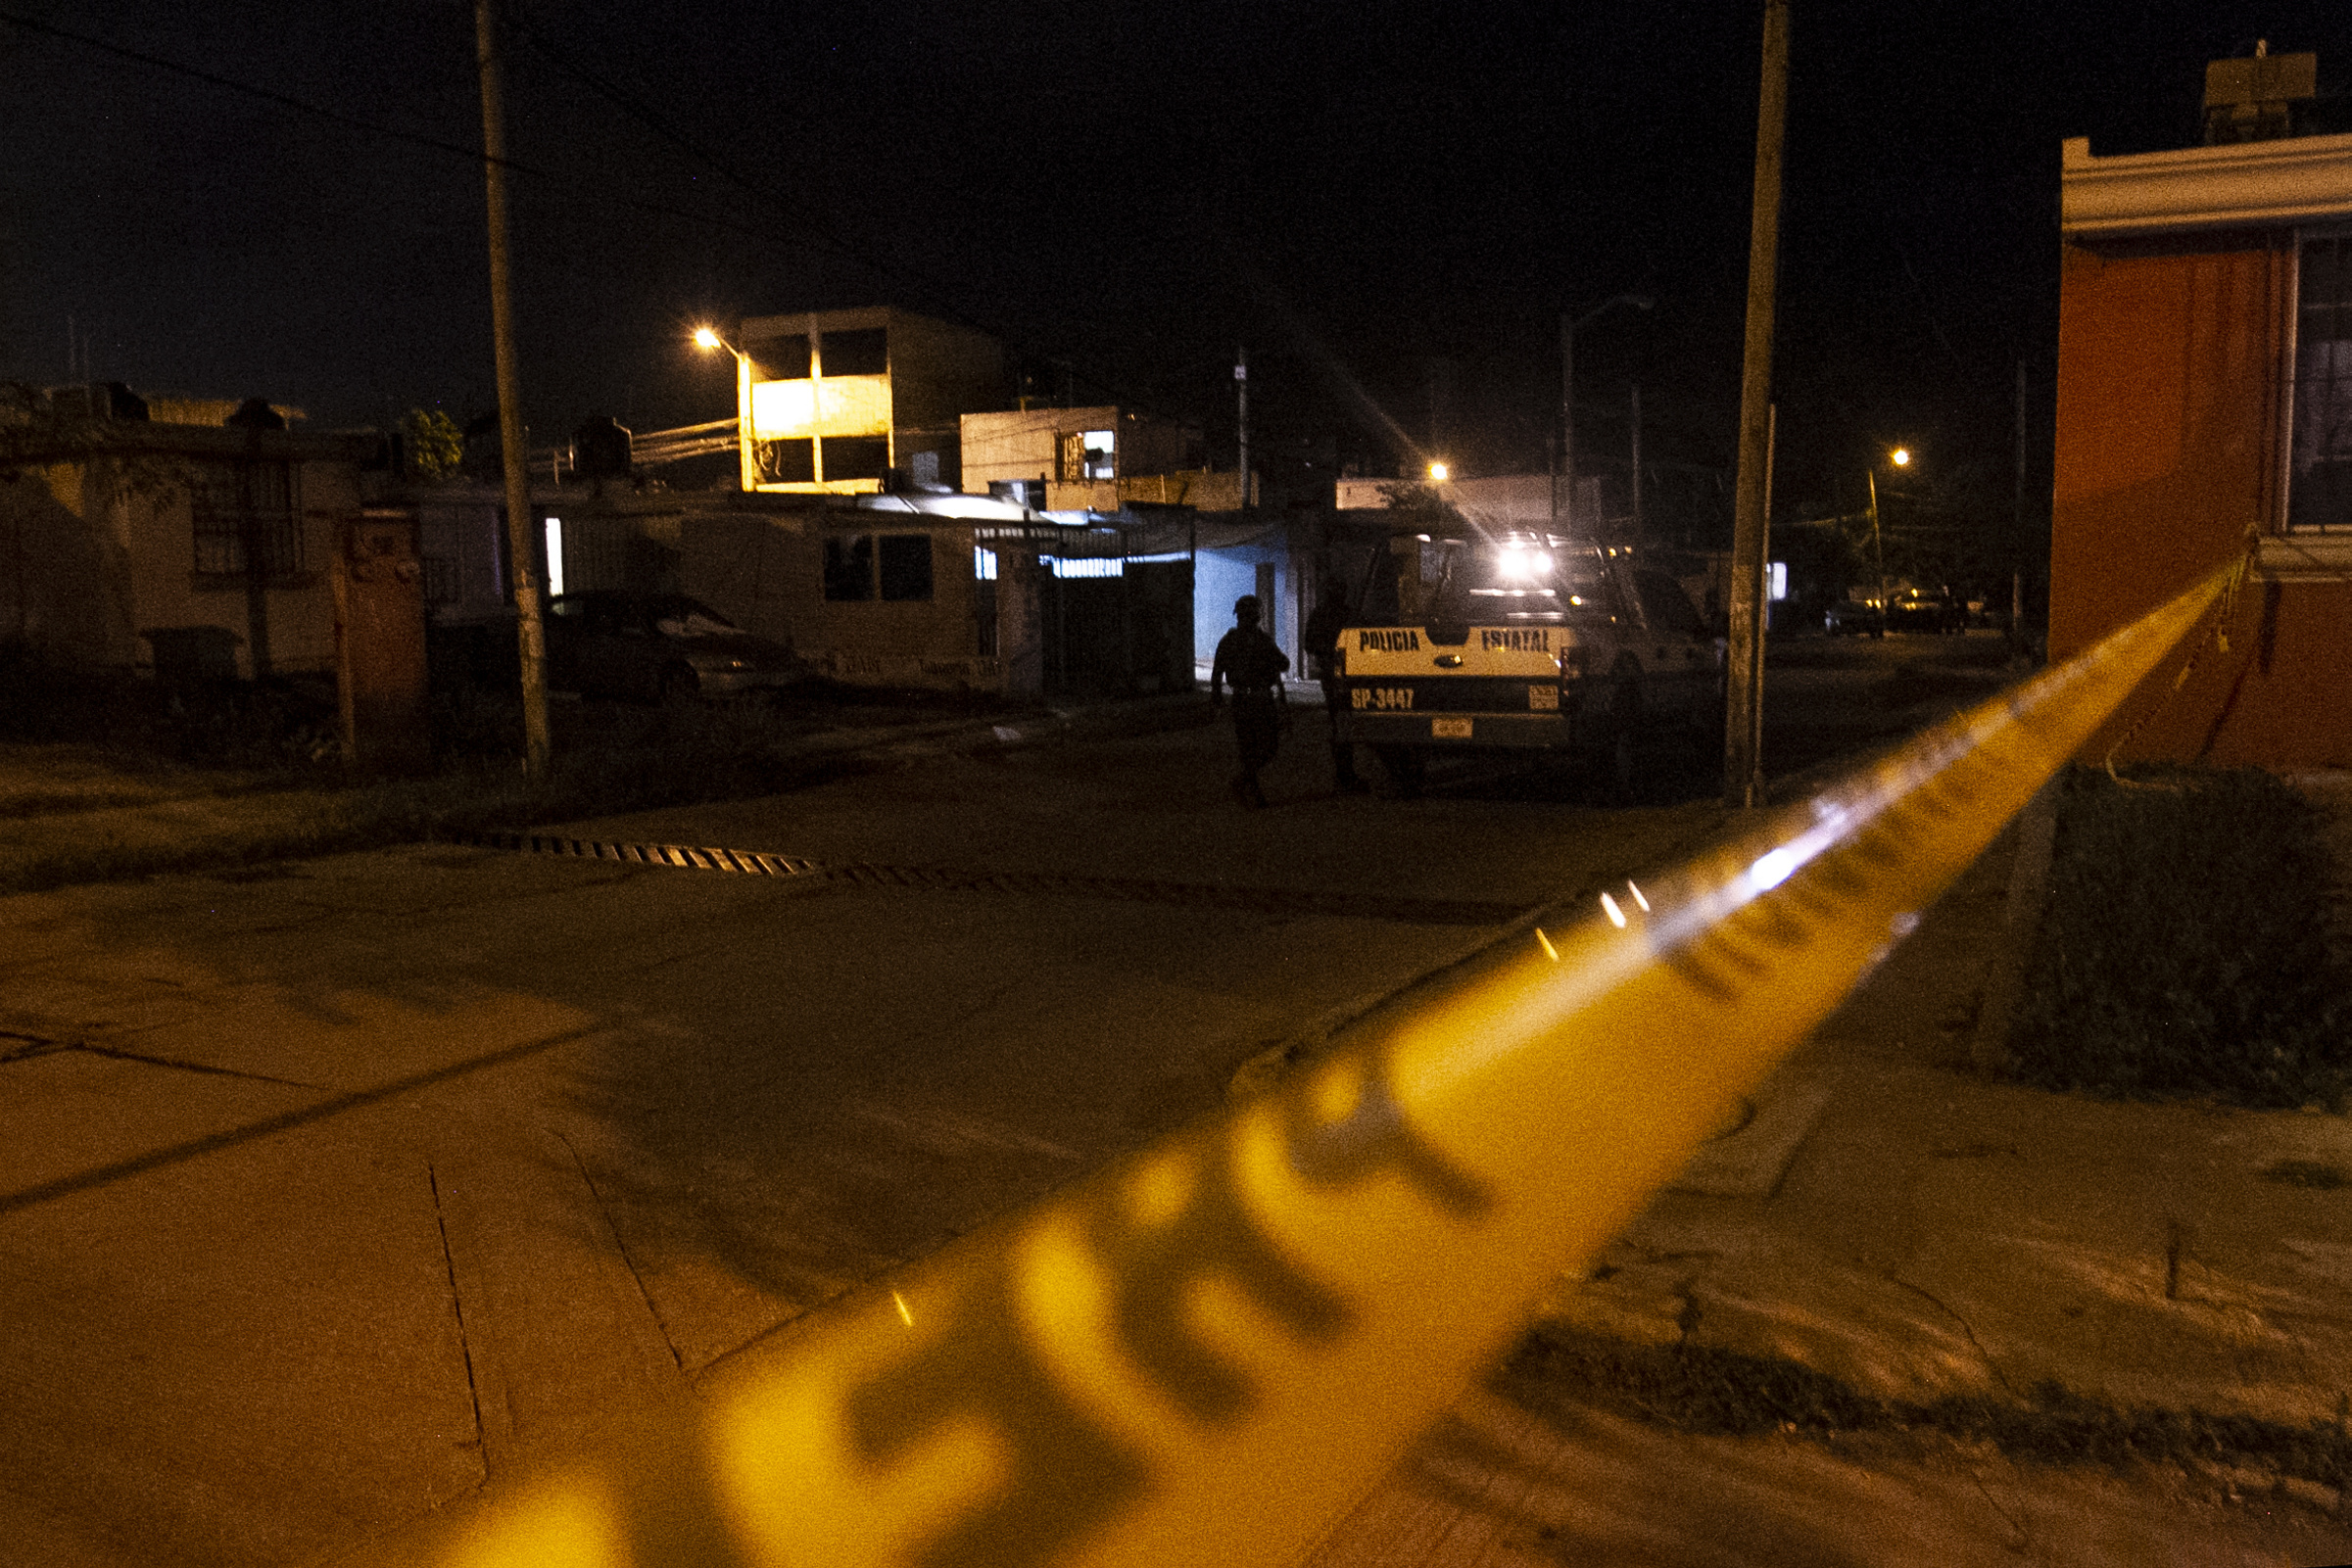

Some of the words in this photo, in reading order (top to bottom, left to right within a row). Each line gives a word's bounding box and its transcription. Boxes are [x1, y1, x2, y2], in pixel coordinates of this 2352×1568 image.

[1360, 630, 1420, 651] POLICIA
[1481, 630, 1550, 652] ESTATAL
[1351, 689, 1415, 709] SP-3447
